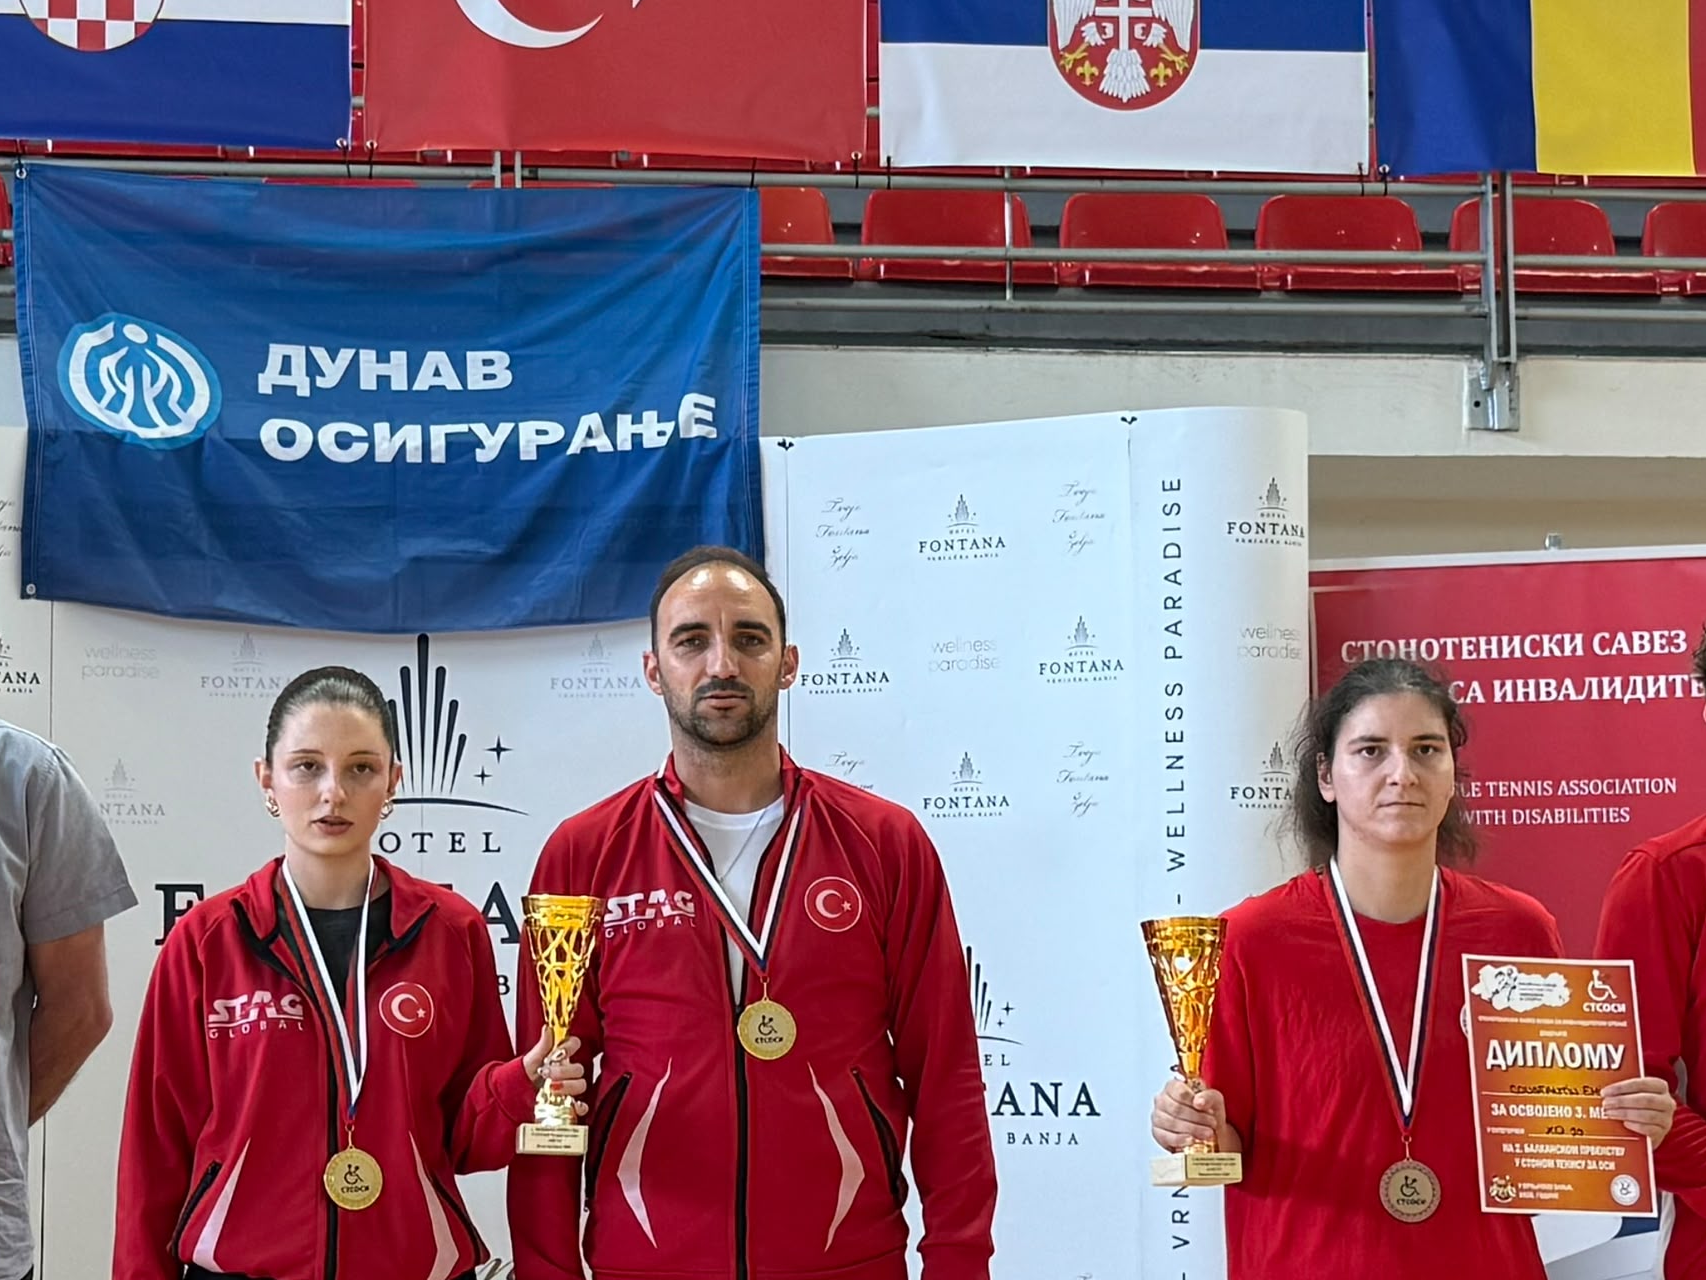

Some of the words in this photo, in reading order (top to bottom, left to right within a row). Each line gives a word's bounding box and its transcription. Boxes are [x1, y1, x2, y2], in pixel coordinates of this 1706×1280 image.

[258, 343, 514, 397] ДУНАВ
[259, 392, 717, 465] ОСИГУРАЊЕ
[919, 536, 1006, 554] FONTANA
[1162, 477, 1183, 660] PARADISE
[1341, 632, 1584, 664] СТОНОТЕНИСКИ
[1593, 630, 1687, 657] САВЕЗ
[1039, 659, 1125, 675] FONTANA
[550, 676, 642, 691] FONTANA
[801, 671, 890, 687] FONTANA
[1164, 681, 1187, 872] WELLNESS
[1487, 780, 1553, 798] TENNIS
[1558, 777, 1677, 798] ASSOCIATION
[100, 803, 165, 817] NTANA
[922, 794, 1010, 811] FONTANA
[1512, 805, 1631, 825] DISABILITIES
[378, 831, 501, 854] OTEL
[604, 888, 696, 925] STAG
[208, 989, 304, 1026] STAG
[1583, 1002, 1626, 1013] СТСОСИ
[209, 1022, 304, 1039] GLOBAL
[1486, 1039, 1625, 1072] ДИПЛОМУ
[1490, 1103, 1506, 1117] ЗА
[1509, 1104, 1573, 1119] ОСВОЈЕНО
[1574, 1108, 1587, 1119] 3.
[1007, 1132, 1079, 1145] BANJA
